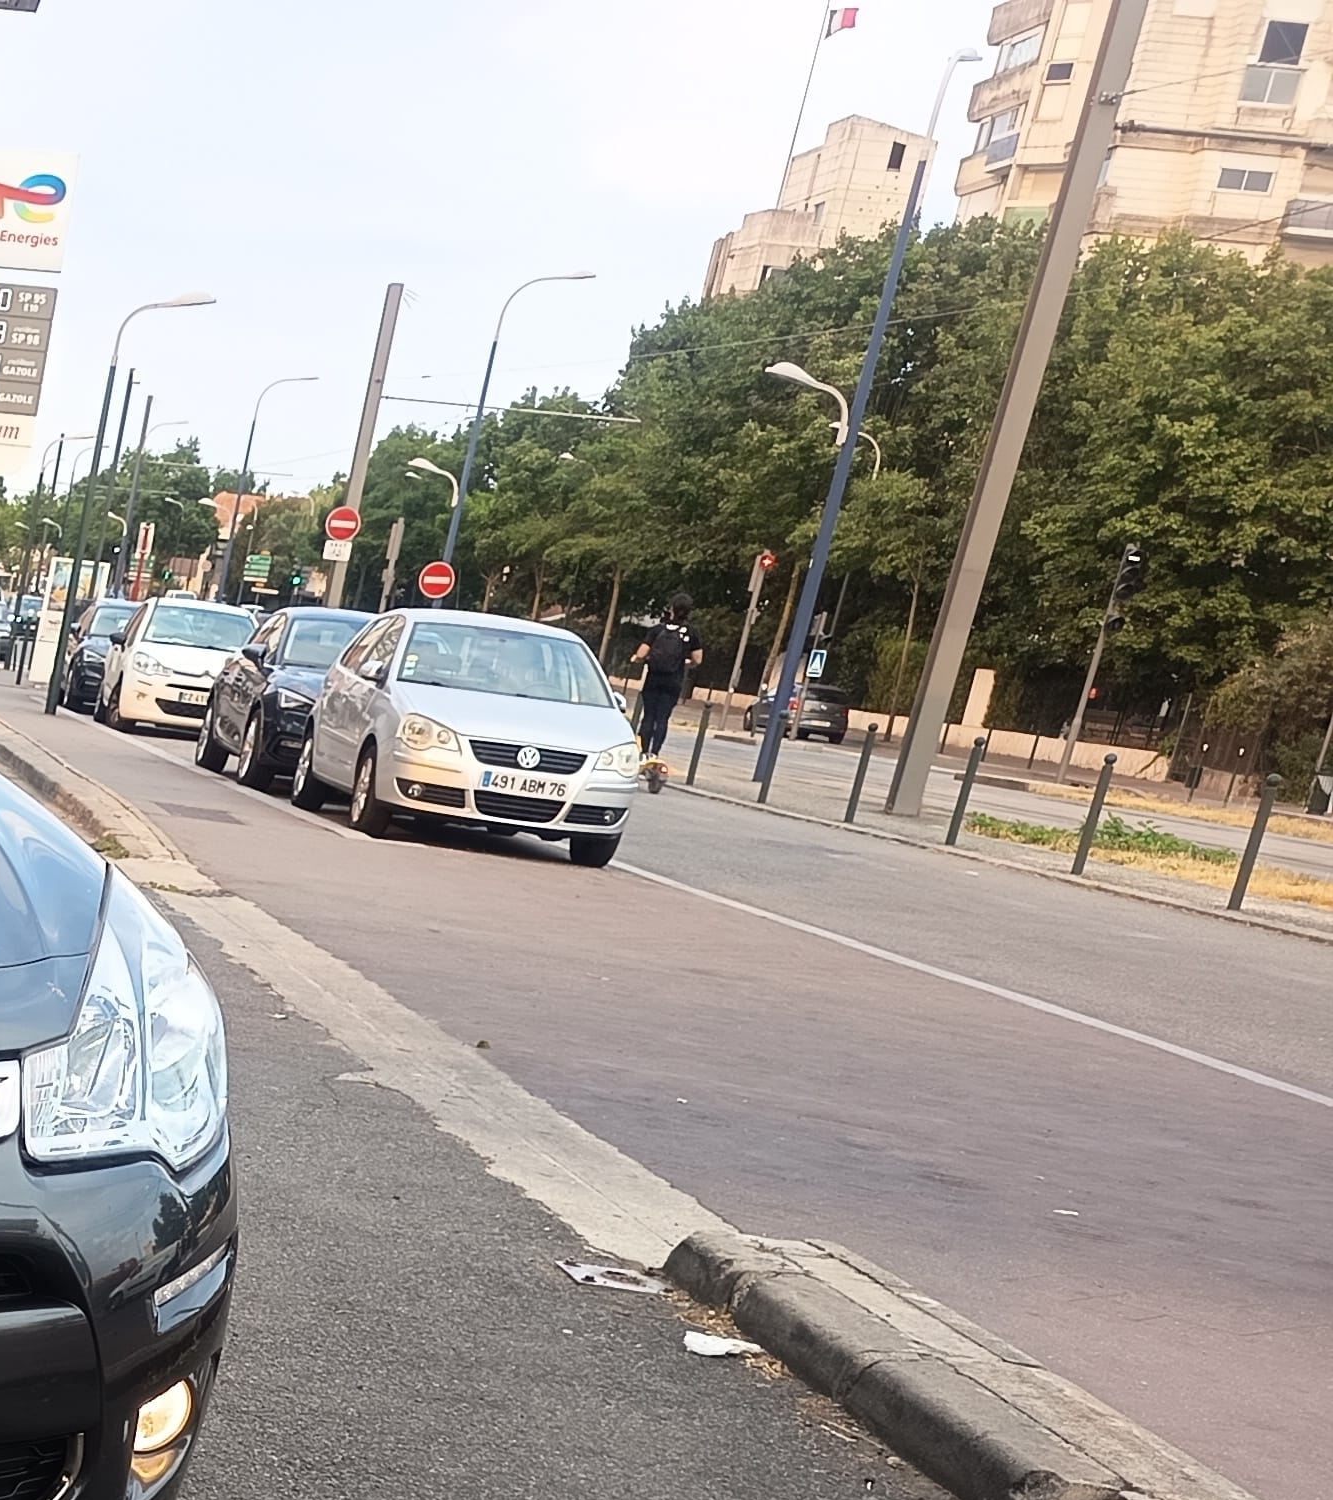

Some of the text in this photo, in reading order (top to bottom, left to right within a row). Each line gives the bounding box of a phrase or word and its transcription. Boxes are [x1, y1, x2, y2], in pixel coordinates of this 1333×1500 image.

[18, 291, 32, 303] SP
[11, 332, 24, 344] SP
[2, 365, 38, 377] GAZOLE
[491, 774, 566, 797] 491 ABM 76
